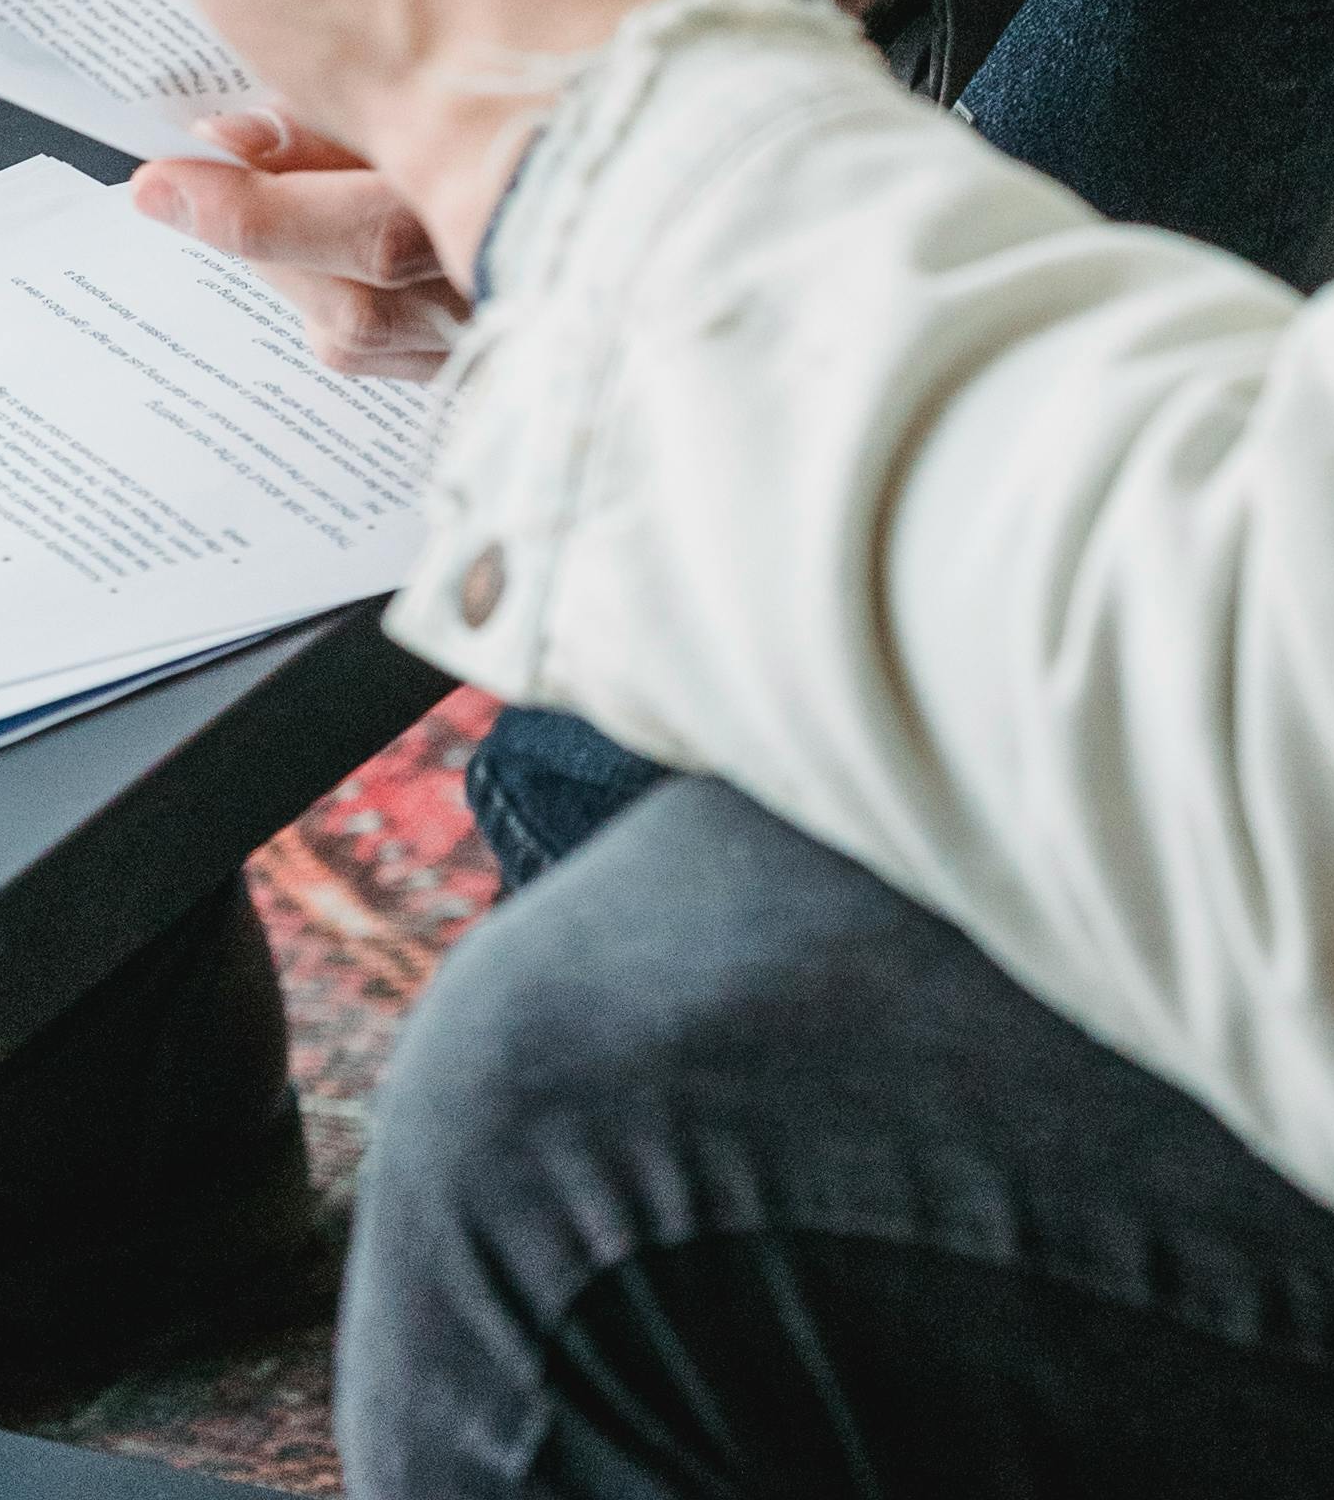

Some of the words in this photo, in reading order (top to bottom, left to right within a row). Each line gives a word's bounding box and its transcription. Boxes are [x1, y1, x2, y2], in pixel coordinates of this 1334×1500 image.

[198, 257, 227, 273] work
[69, 273, 114, 302] exploring
[222, 271, 254, 289] safely
[22, 284, 47, 299] view
[215, 287, 256, 312] working
[247, 288, 270, 300] can
[247, 311, 275, 326] start
[269, 324, 292, 338] can
[166, 340, 188, 353] the
[180, 427, 220, 448] next
[210, 446, 239, 463] the
[230, 461, 257, 476] for
[242, 472, 289, 498] about
